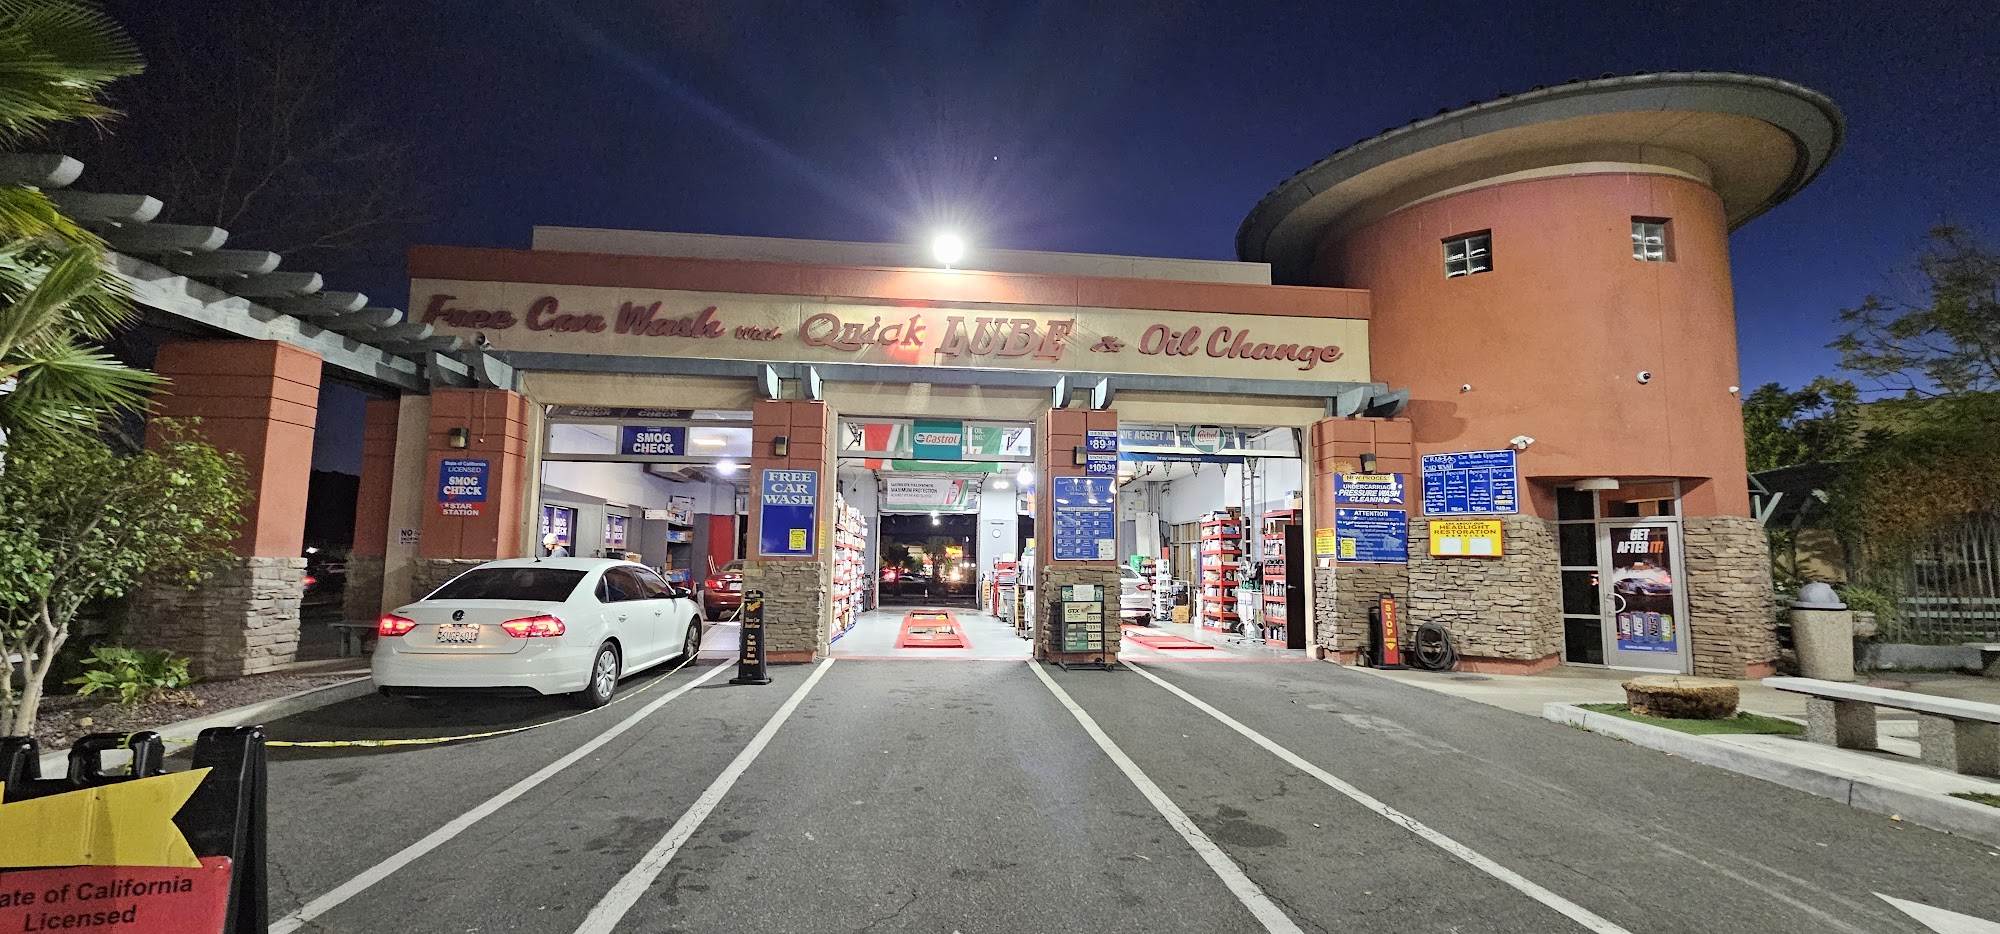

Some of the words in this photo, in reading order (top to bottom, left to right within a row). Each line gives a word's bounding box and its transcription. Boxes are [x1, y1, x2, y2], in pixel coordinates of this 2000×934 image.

[422, 294, 518, 330] Free
[525, 296, 607, 333] Car
[615, 301, 725, 338] Wash
[800, 313, 926, 352] Quick
[935, 315, 1075, 361] LUBE
[1089, 335, 1126, 352] &
[1138, 323, 1202, 357] Oil
[1206, 326, 1345, 370] Change
[636, 433, 672, 444] SMOG
[925, 434, 957, 444] Castrol
[1119, 430, 1132, 440] WE
[1134, 431, 1164, 440] ACCEPT
[632, 443, 674, 454] CHECK
[1090, 439, 1116, 450] $89.99
[1483, 452, 1509, 460] Upgrades
[1089, 463, 1116, 472] $109.99
[448, 476, 478, 486] SMOG
[768, 471, 812, 482] FREE
[443, 485, 482, 496] CHECK
[771, 483, 808, 494] CAR
[764, 494, 814, 505] WASH
[1630, 529, 1650, 541] GET
[1617, 541, 1649, 554] AFTER
[1650, 541, 1665, 554] IT!
[1384, 604, 1394, 636] STOP
[1633, 615, 1644, 637] NOS
[1649, 616, 1658, 637] NOS
[0, 890, 35, 908] ate
[44, 884, 71, 903] of
[77, 876, 193, 901] California
[24, 904, 137, 933] Licensed
